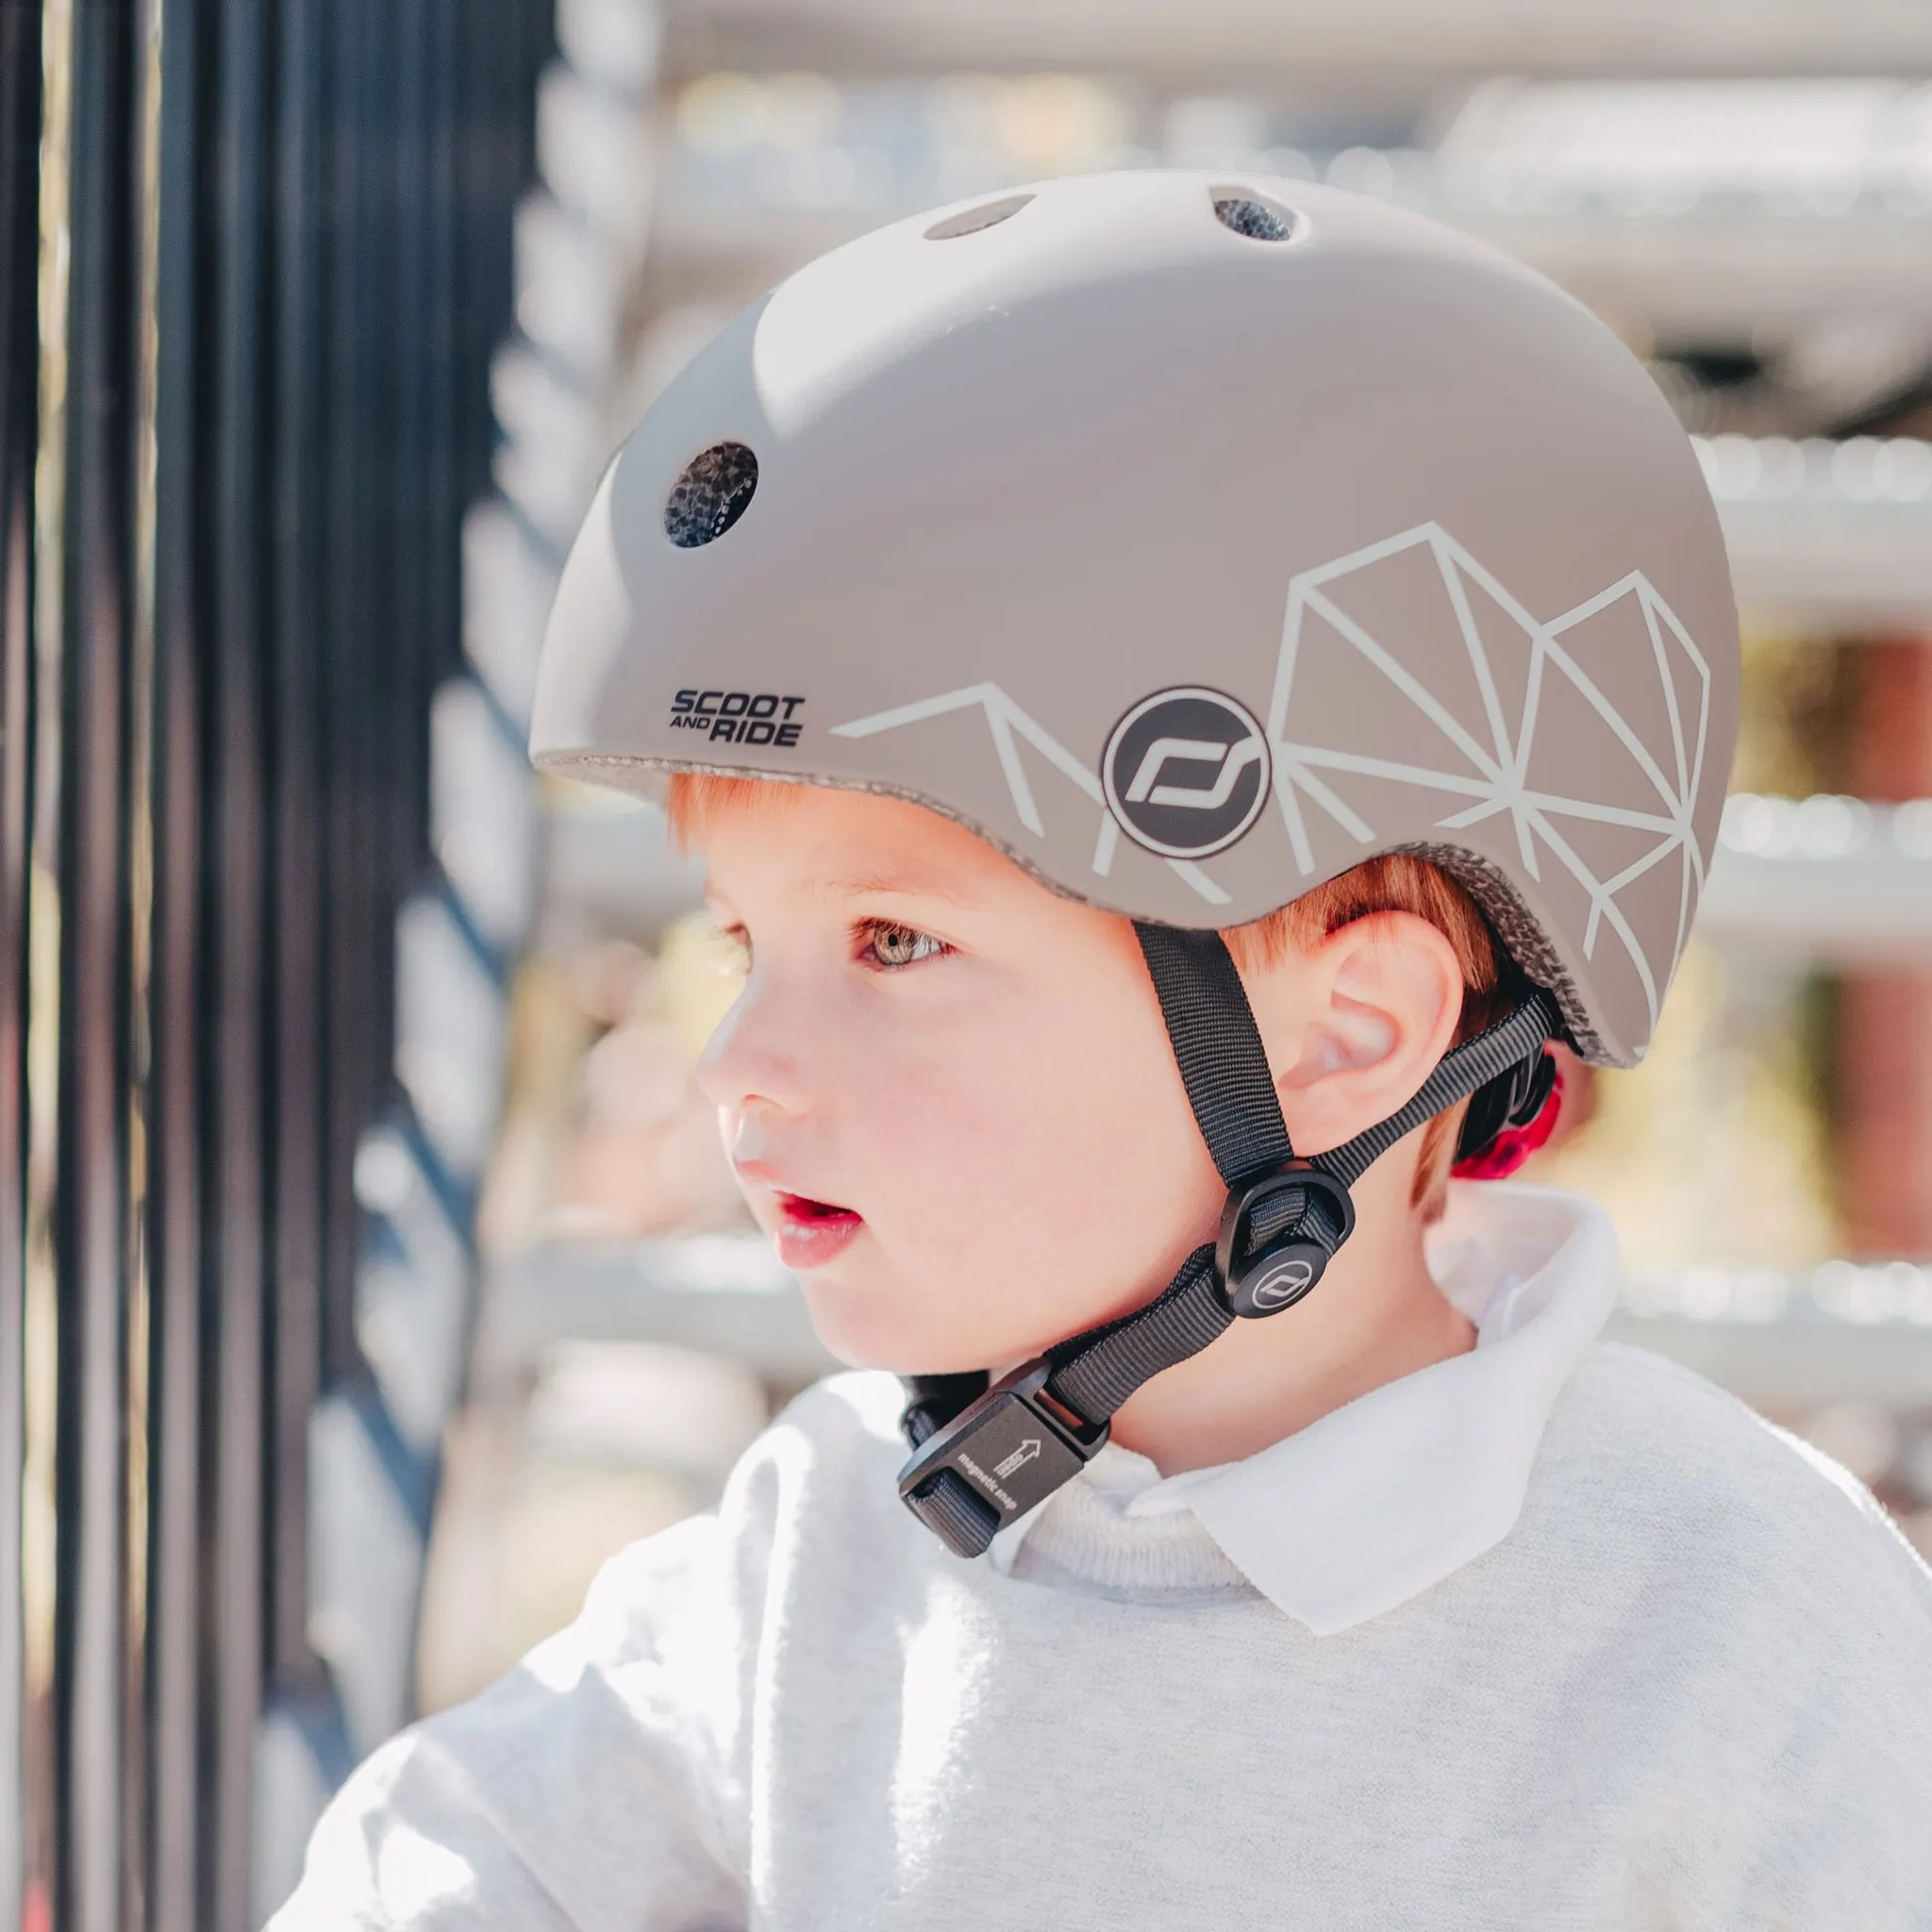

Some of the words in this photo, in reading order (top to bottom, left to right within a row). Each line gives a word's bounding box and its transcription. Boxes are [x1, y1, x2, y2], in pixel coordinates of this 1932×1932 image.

[670, 690, 806, 720] SCOOT
[669, 715, 710, 729] AND
[708, 718, 804, 747] RIDE
